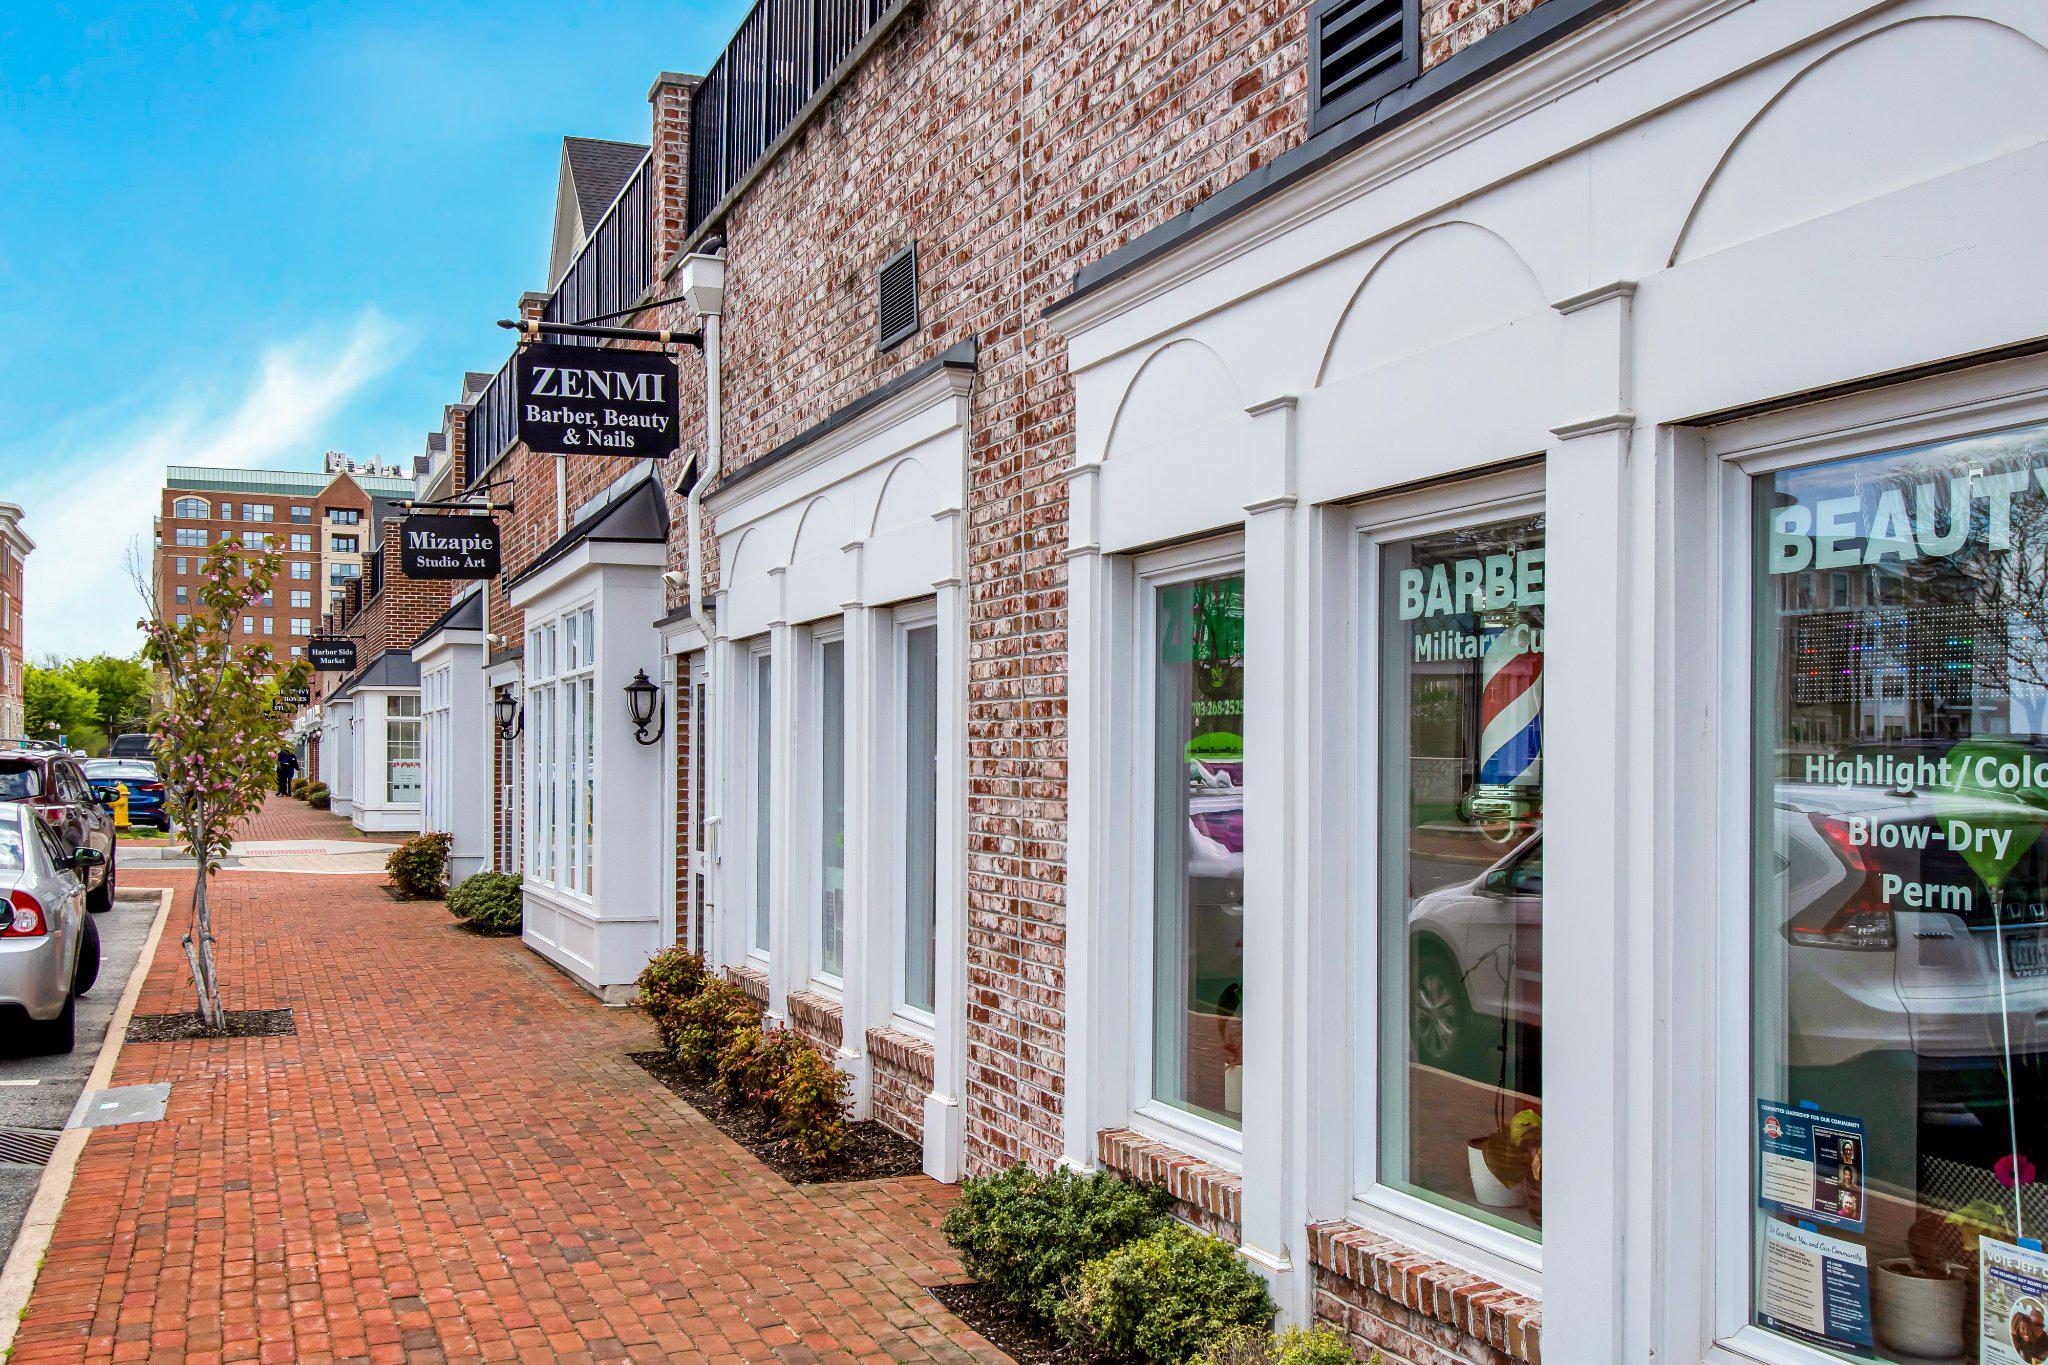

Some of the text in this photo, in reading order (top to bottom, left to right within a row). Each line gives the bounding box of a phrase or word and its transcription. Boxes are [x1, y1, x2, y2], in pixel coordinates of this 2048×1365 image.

[530, 366, 666, 403] ZENMI
[525, 404, 670, 433] Barber, Beauty
[562, 428, 635, 448] & Nails
[408, 531, 493, 555] Mizapie
[416, 555, 486, 568] Studio Art
[311, 648, 354, 656] Harbor Side
[1849, 815, 2013, 860] Blow-Dry
[1882, 873, 1972, 911] Perm
[1830, 1118, 1860, 1129] COMMUNITY
[1831, 1245, 1862, 1263] Community
[1986, 1250, 2013, 1268] VOTE
[2015, 1260, 2040, 1275] JEFF
